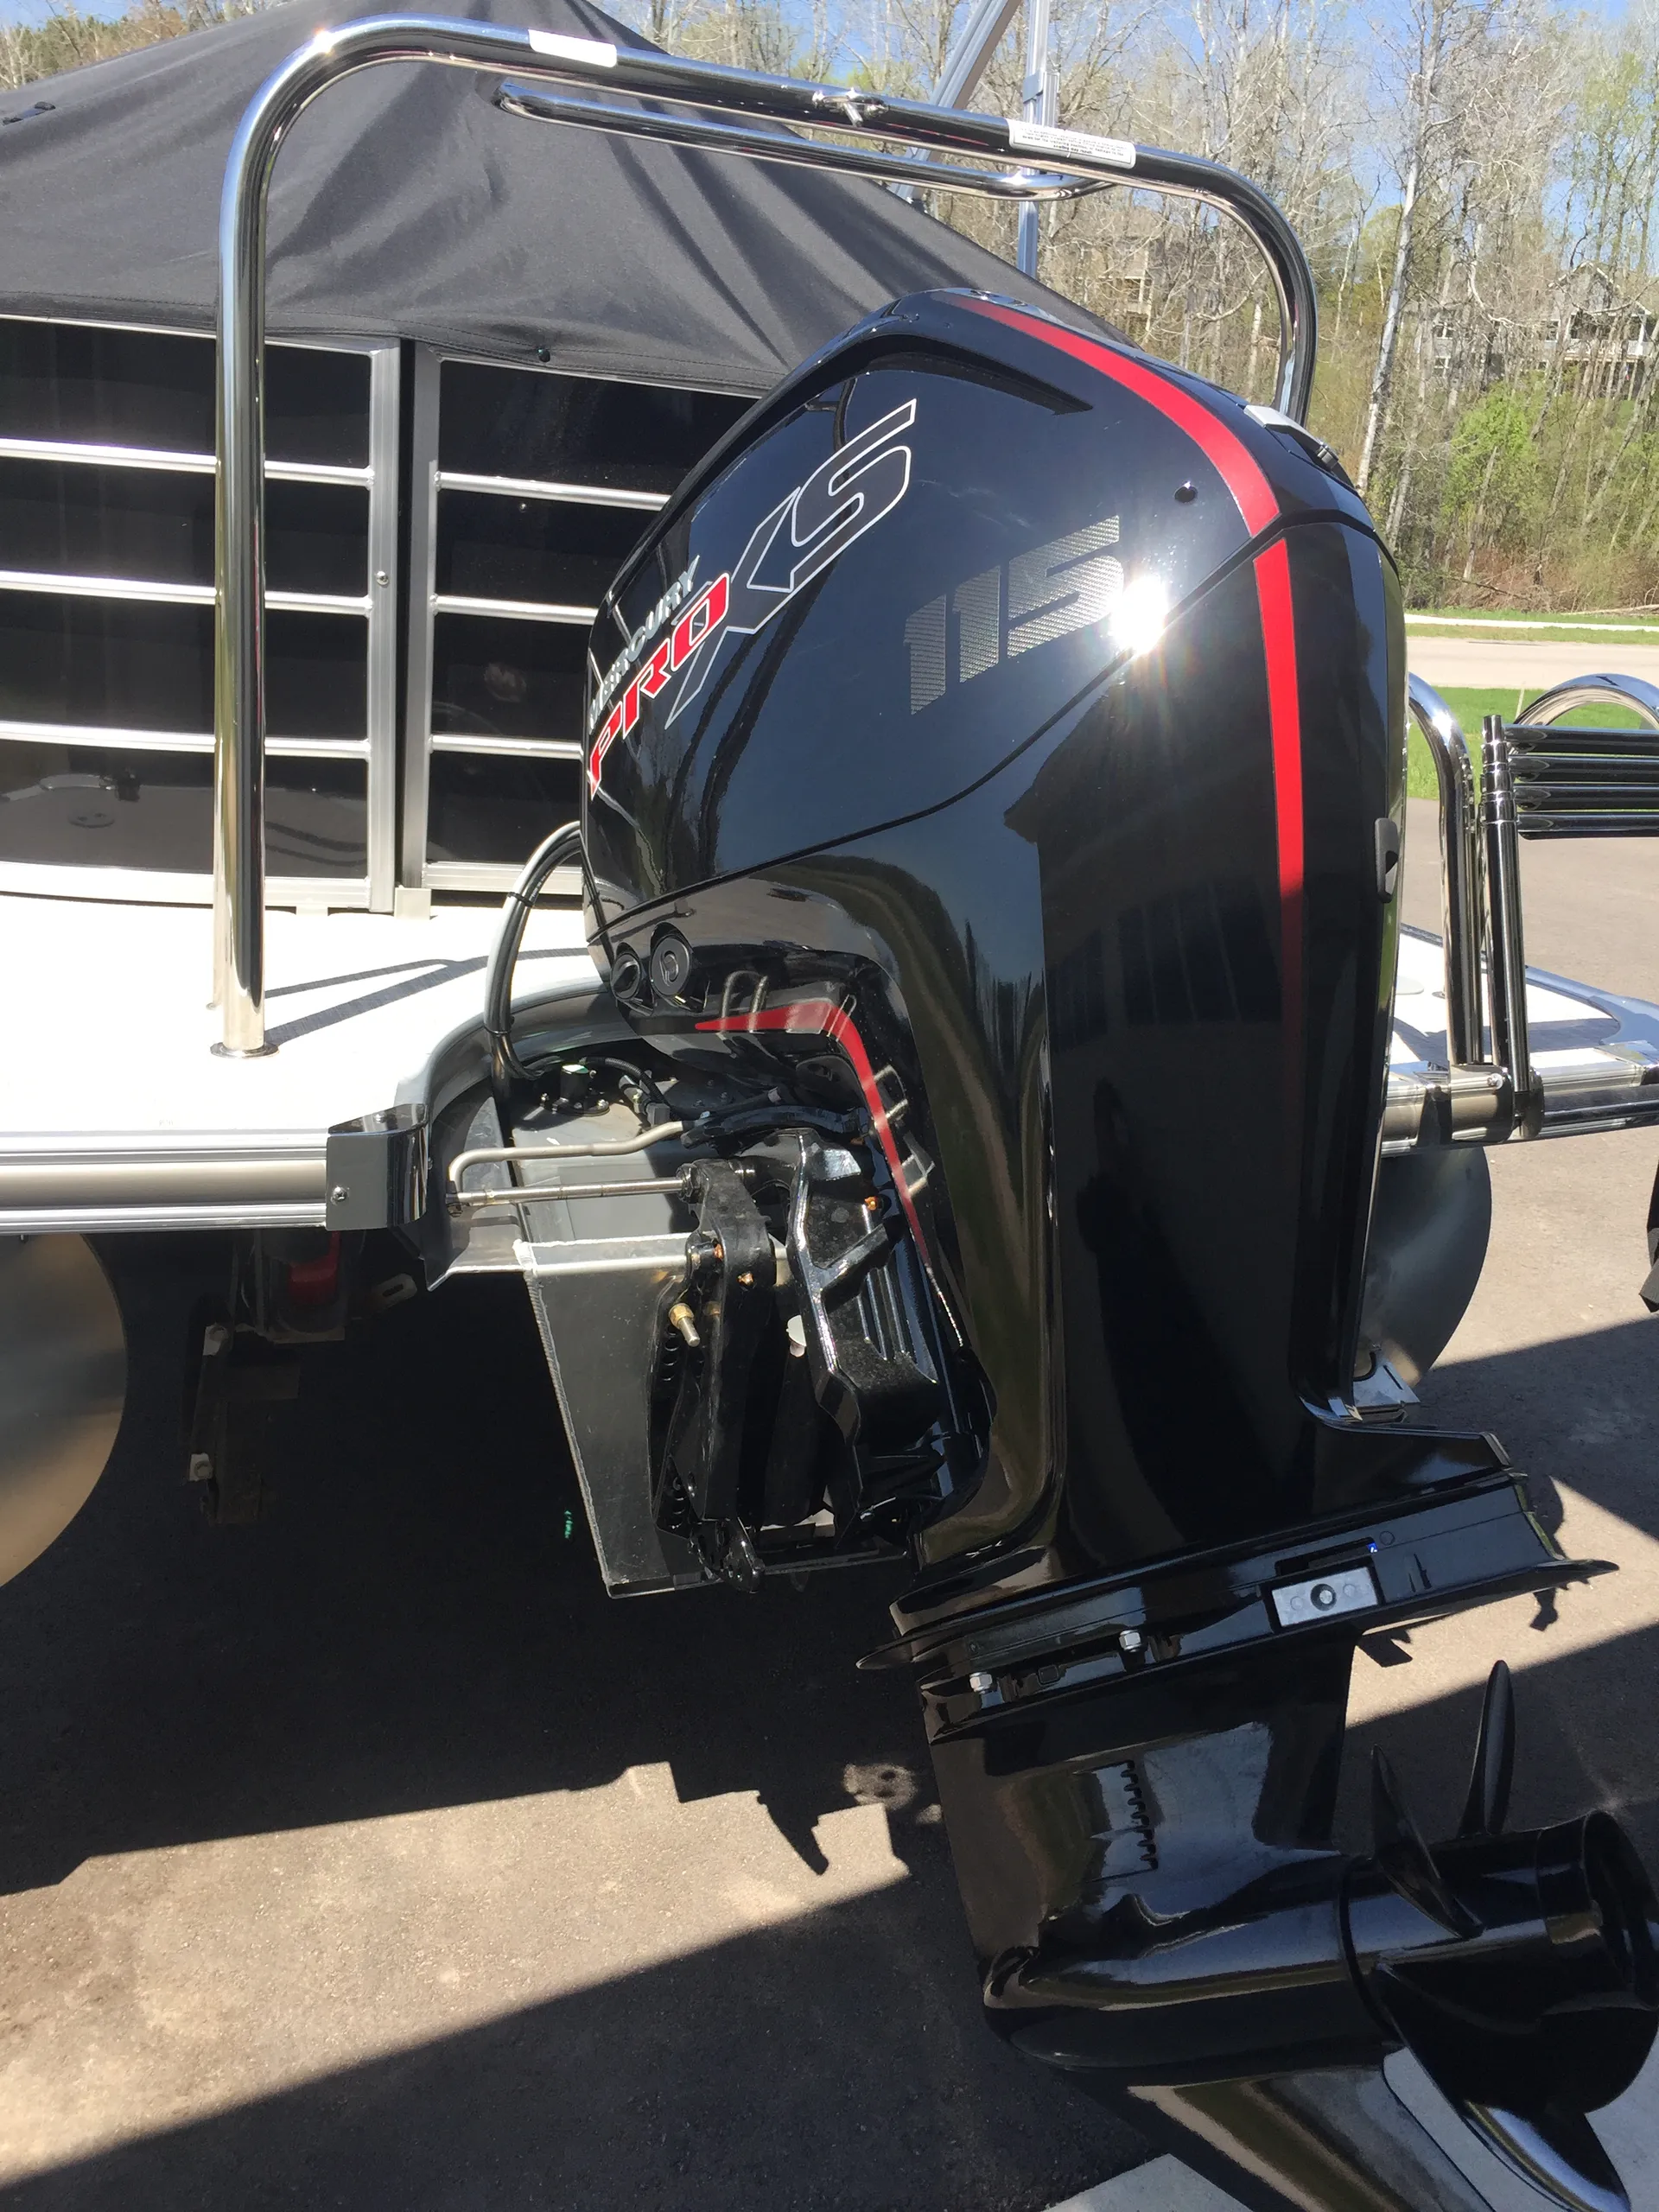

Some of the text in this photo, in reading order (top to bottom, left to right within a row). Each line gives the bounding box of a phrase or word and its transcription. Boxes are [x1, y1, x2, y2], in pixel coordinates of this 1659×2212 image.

[587, 398, 917, 801] PRO XS
[904, 515, 1124, 715] 115
